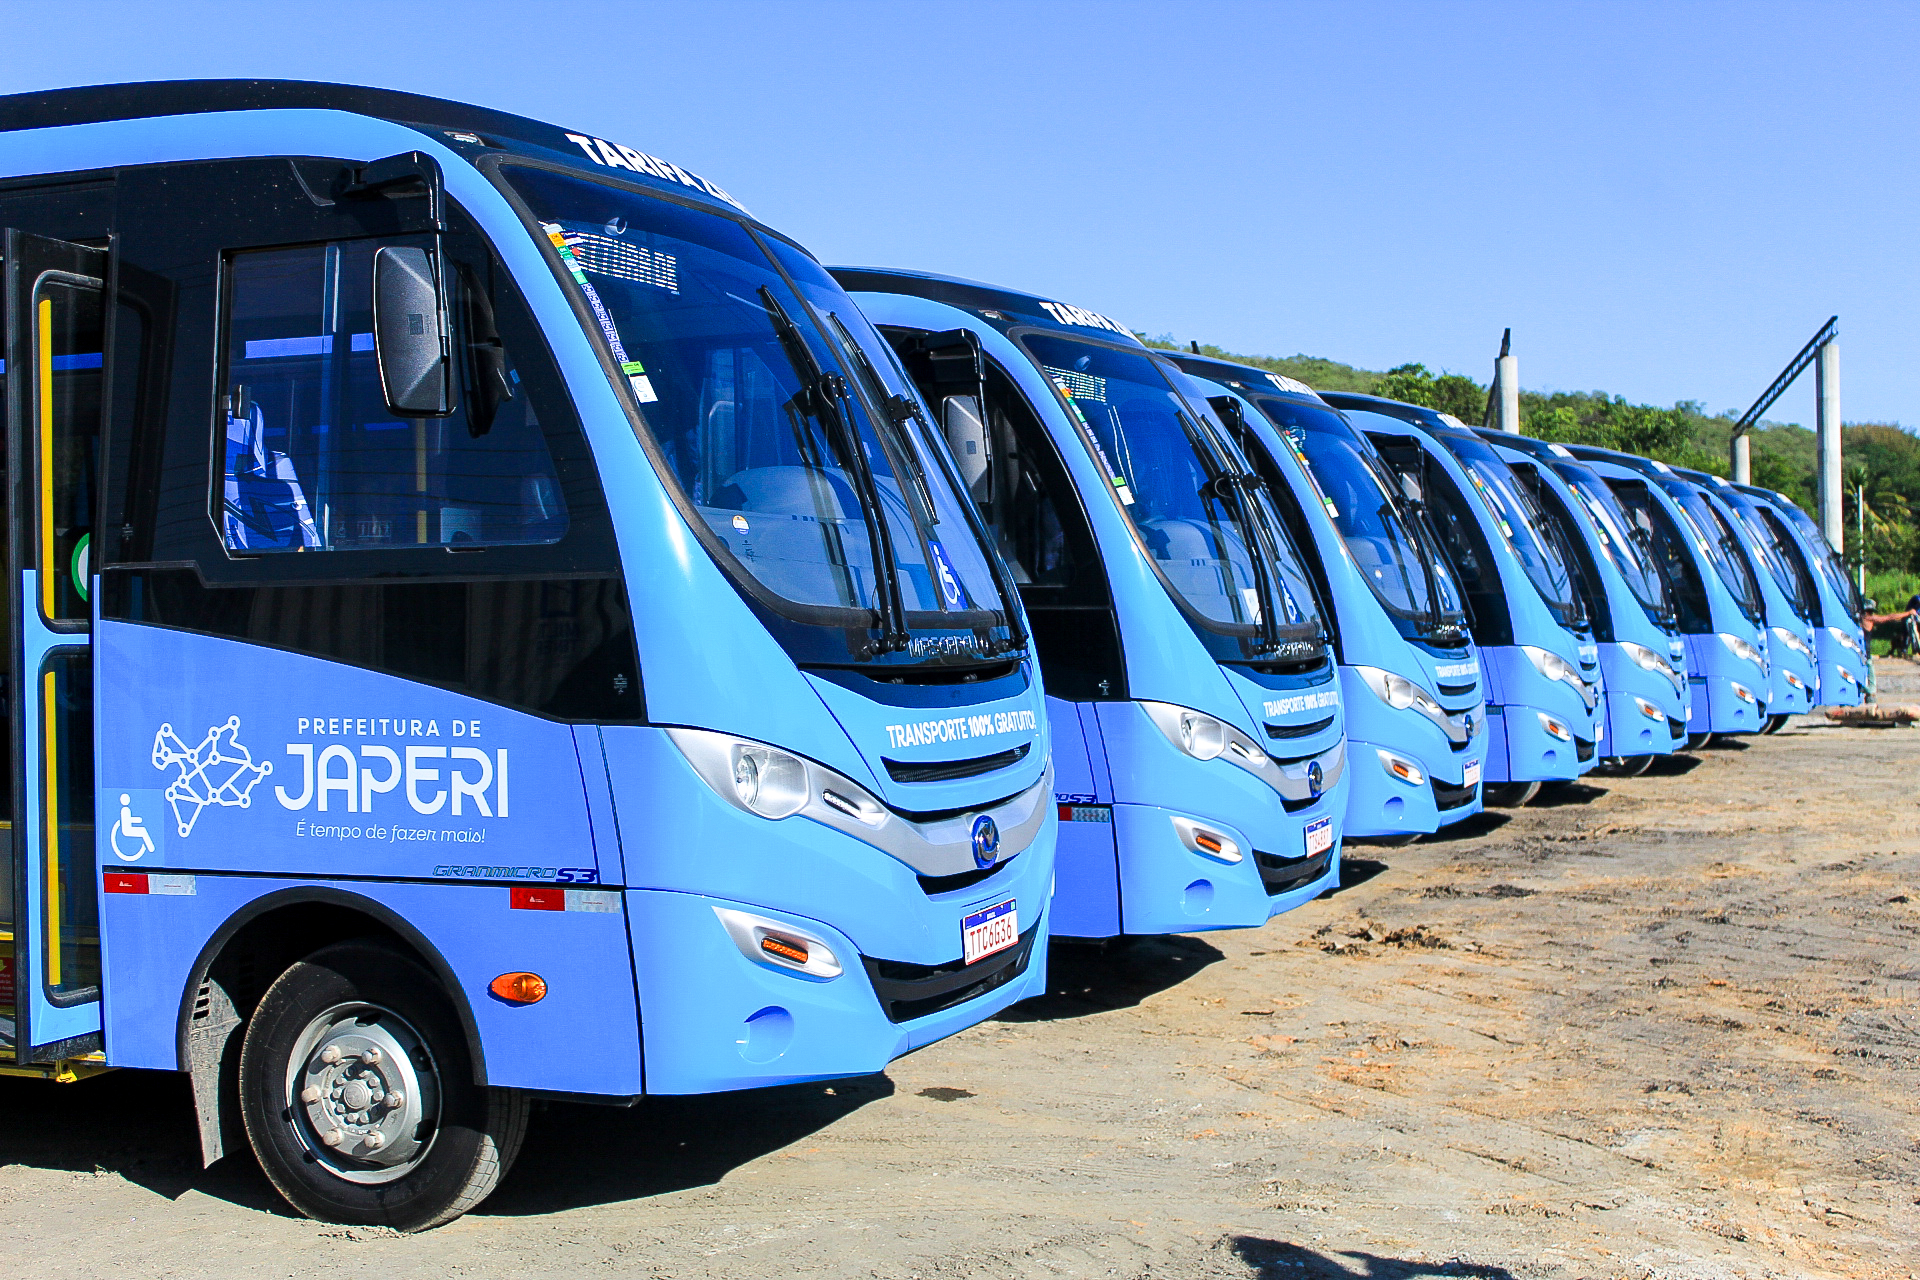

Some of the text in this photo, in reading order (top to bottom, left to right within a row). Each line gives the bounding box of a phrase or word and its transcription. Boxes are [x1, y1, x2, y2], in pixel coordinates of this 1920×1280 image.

[564, 133, 706, 192] TARIFA
[1038, 301, 1120, 333] TARIFA
[298, 717, 482, 738] PREFEITURA DE
[886, 709, 1037, 749] TRANSPORTE 100% GRATUITO!
[274, 743, 509, 818] JAPERI
[296, 818, 486, 843] É tempo de fazer mais!
[970, 915, 1012, 956] TTC6G36
